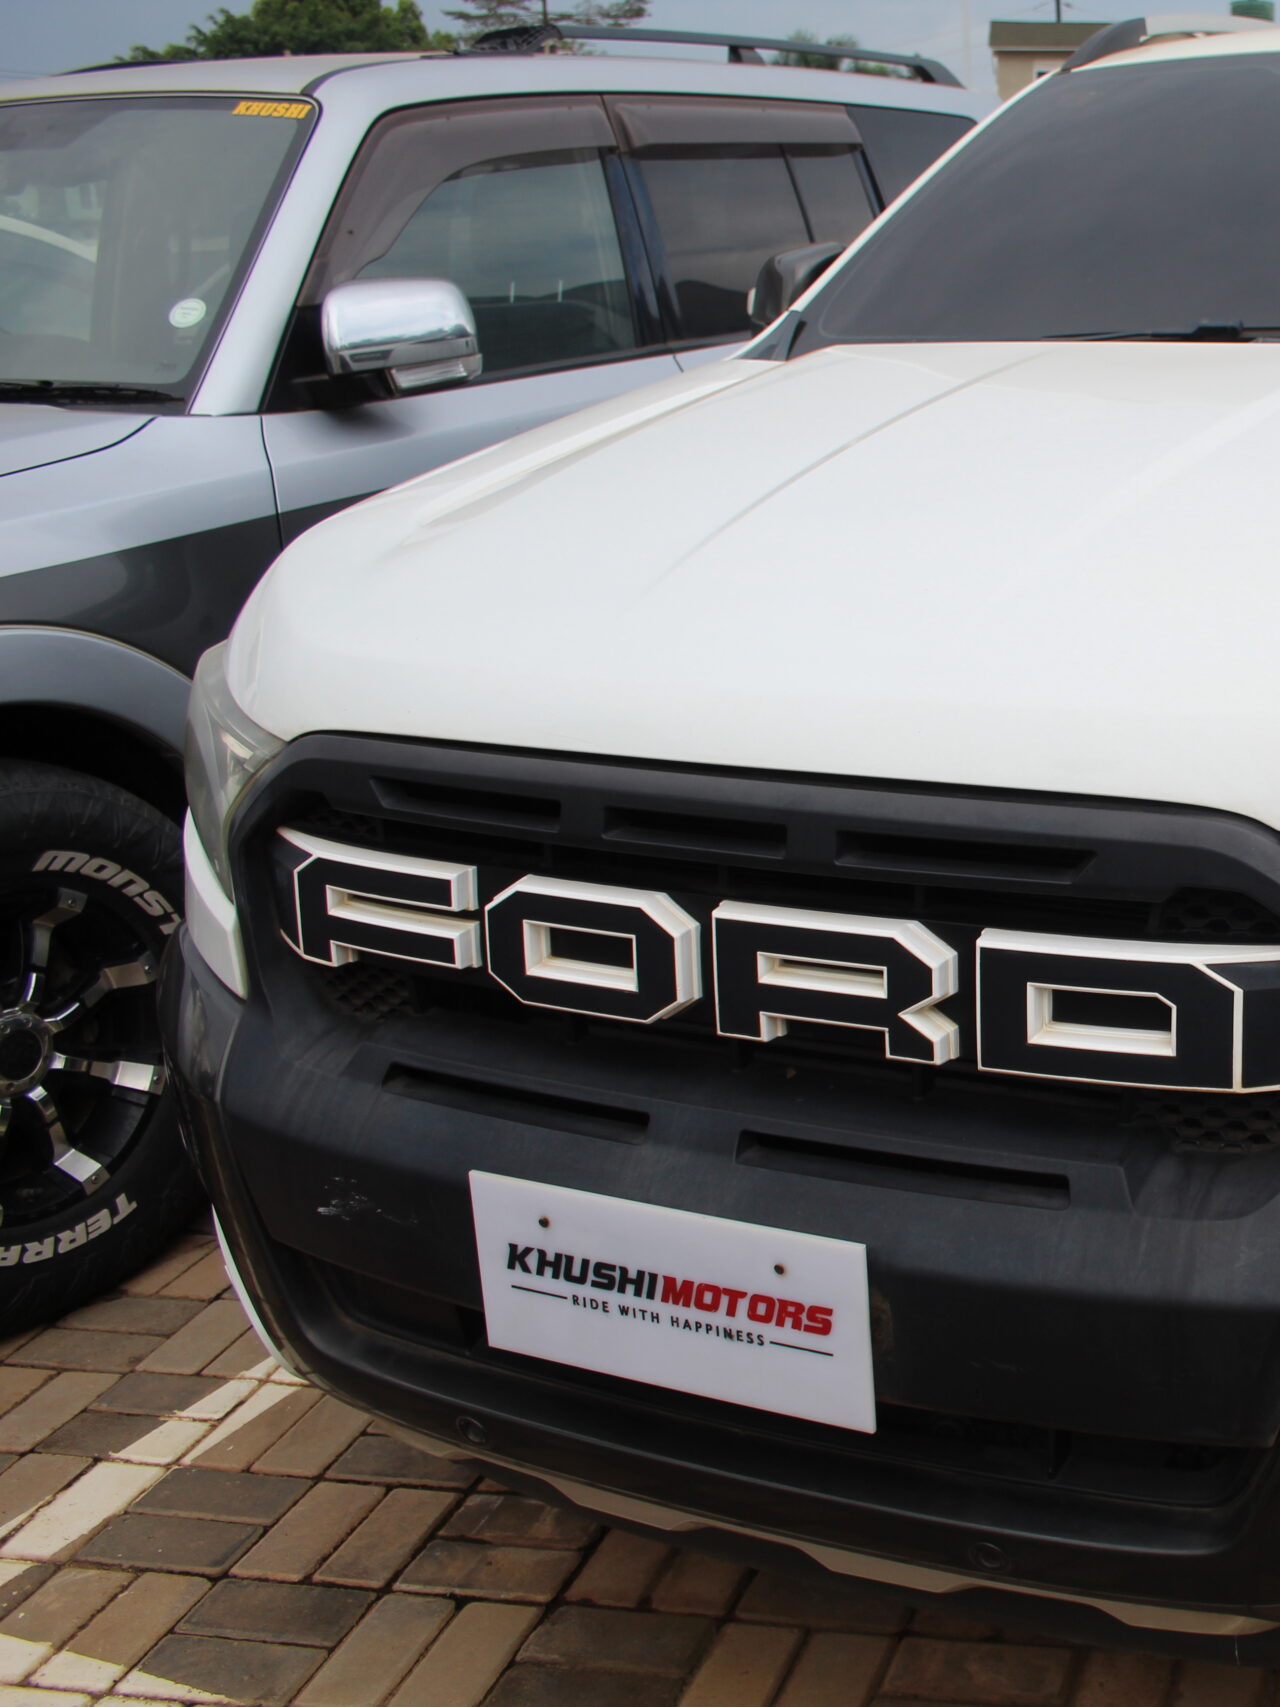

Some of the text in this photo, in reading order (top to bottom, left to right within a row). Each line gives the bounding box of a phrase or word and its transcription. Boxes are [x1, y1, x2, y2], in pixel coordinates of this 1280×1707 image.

[231, 101, 313, 119] KHUSHI
[279, 828, 1246, 1094] FORD
[572, 1294, 765, 1346] RIDE WITH HAPPINESS
